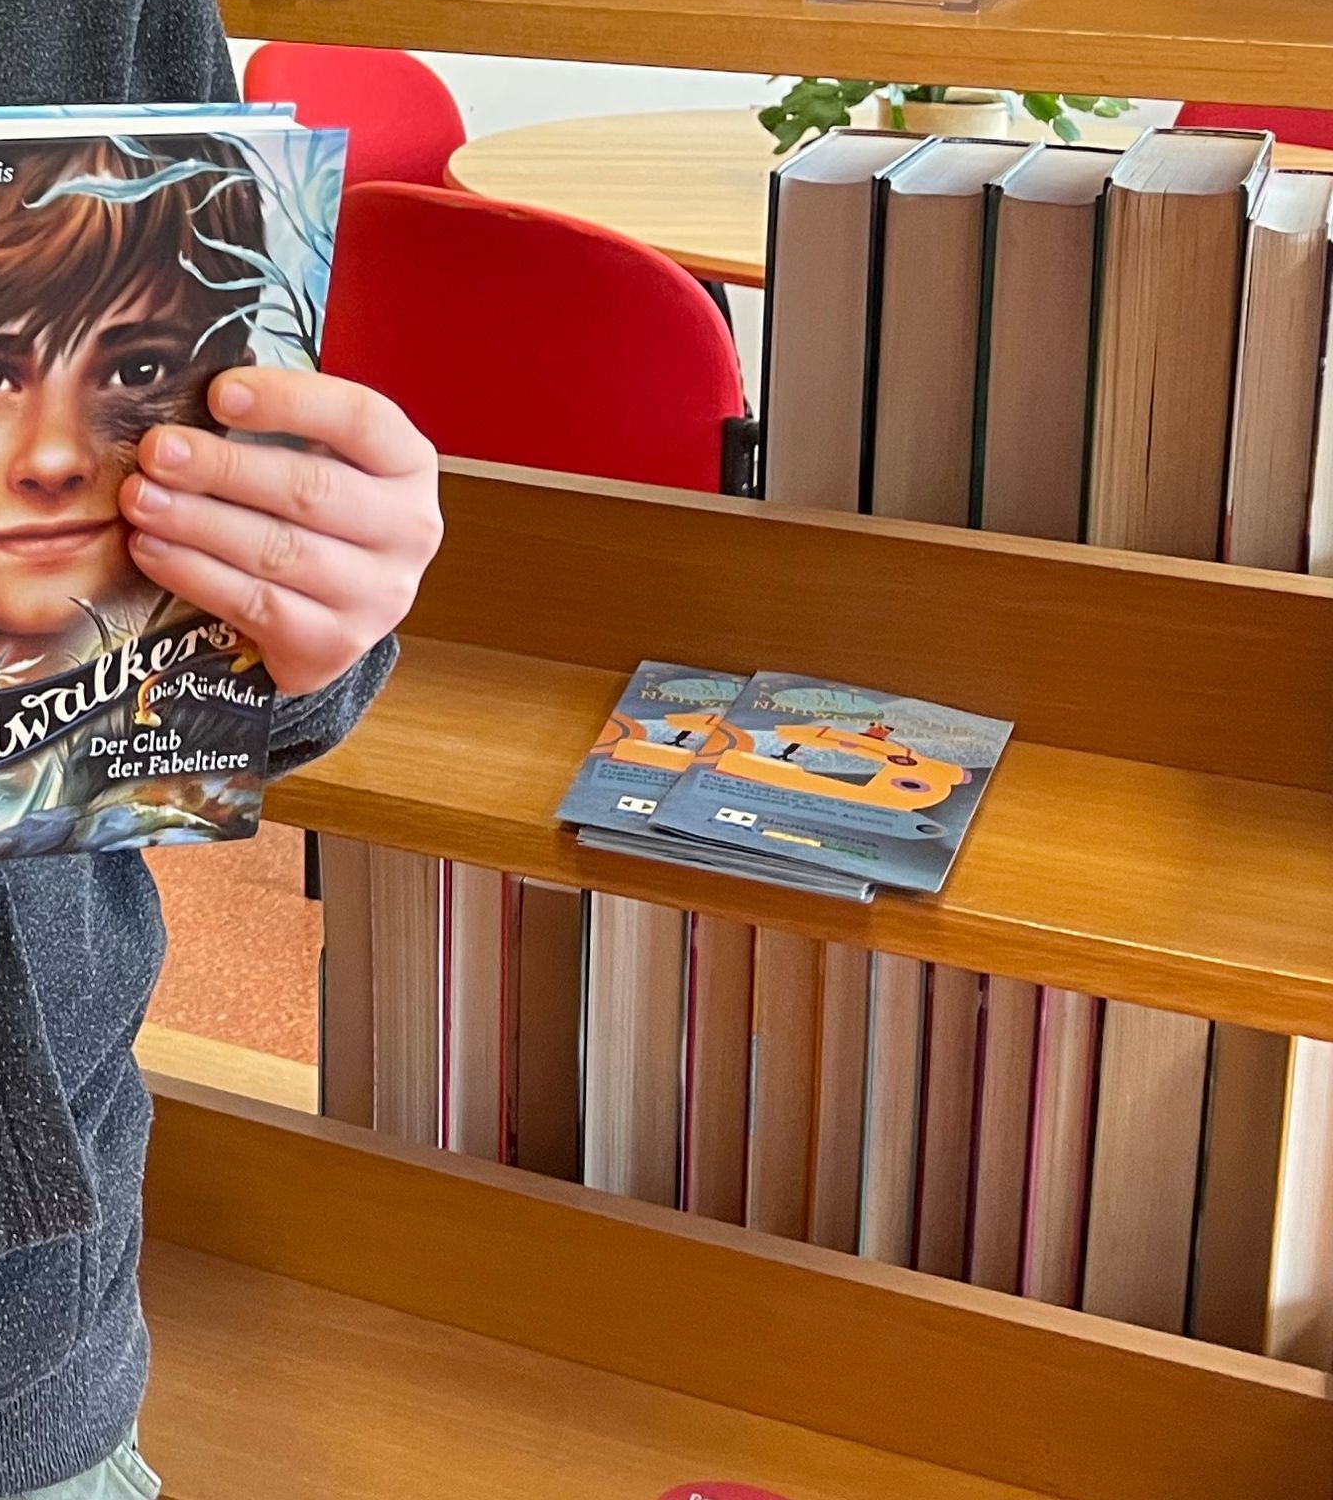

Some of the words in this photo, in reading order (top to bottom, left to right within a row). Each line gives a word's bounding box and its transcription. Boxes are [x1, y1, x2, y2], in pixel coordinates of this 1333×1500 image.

[147, 681, 174, 705] Die
[174, 671, 269, 708] Rückkehr
[90, 737, 128, 756] Der
[133, 729, 181, 752] Club
[108, 757, 142, 779] der
[148, 750, 249, 775] Fabeltiere
